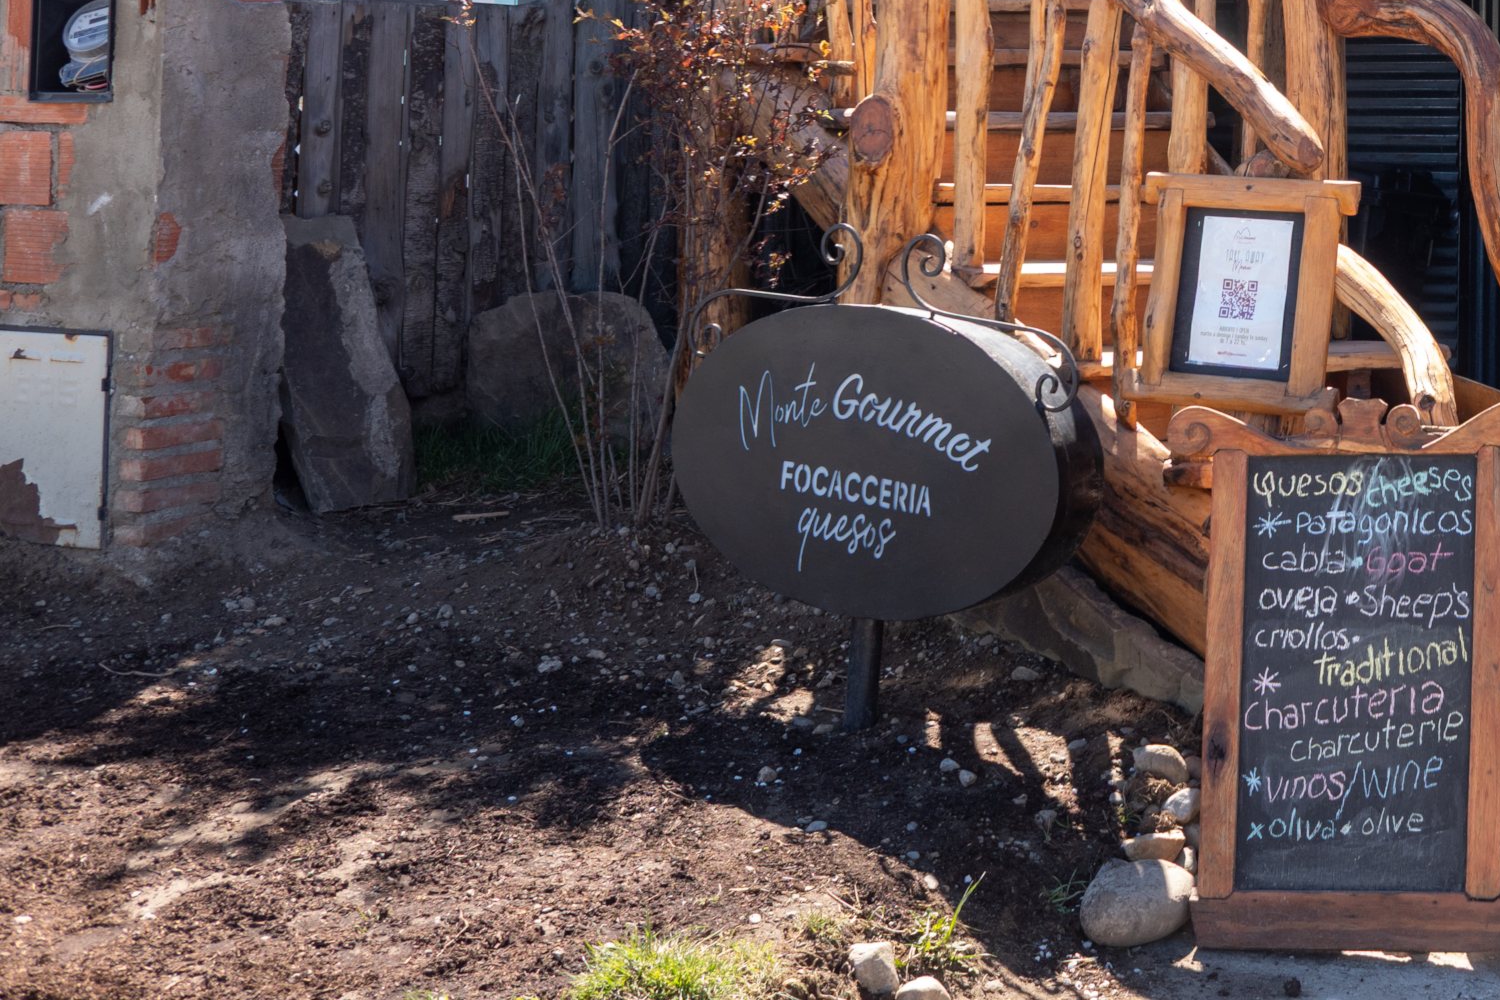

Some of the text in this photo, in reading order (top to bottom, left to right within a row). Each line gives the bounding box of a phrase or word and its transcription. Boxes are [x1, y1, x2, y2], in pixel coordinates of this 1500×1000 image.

[738, 361, 992, 472] Monte Gourmet
[780, 460, 932, 517] FOCACCERIA
[797, 506, 897, 572] quesos
